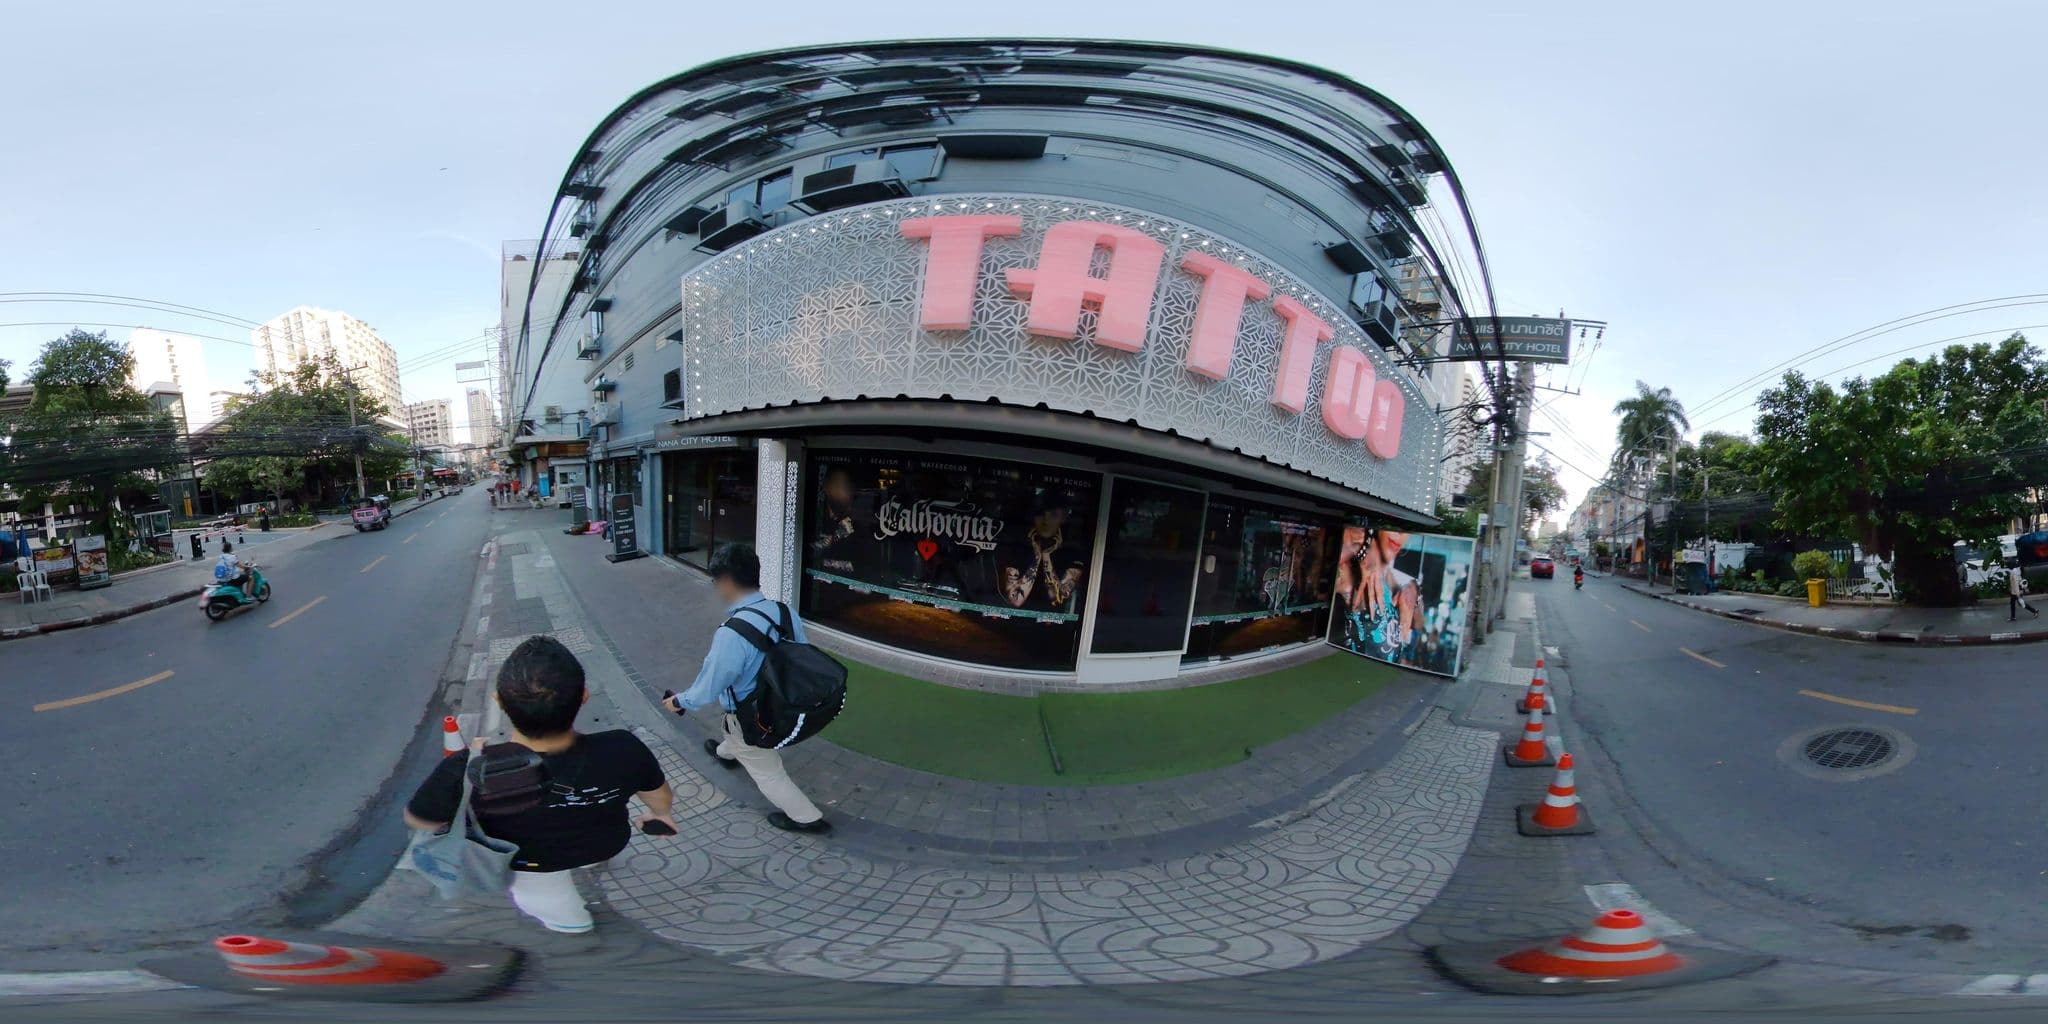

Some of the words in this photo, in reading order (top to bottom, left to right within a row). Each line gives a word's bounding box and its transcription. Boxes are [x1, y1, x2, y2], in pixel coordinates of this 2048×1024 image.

[900, 213, 1406, 461] TATTOO
[1497, 342, 1523, 351] ITY
[1527, 342, 1562, 354] HOTEL
[657, 440, 679, 448] NANA
[680, 437, 698, 446] CITY
[701, 435, 733, 443] HOTEL
[873, 495, 1005, 553] California
